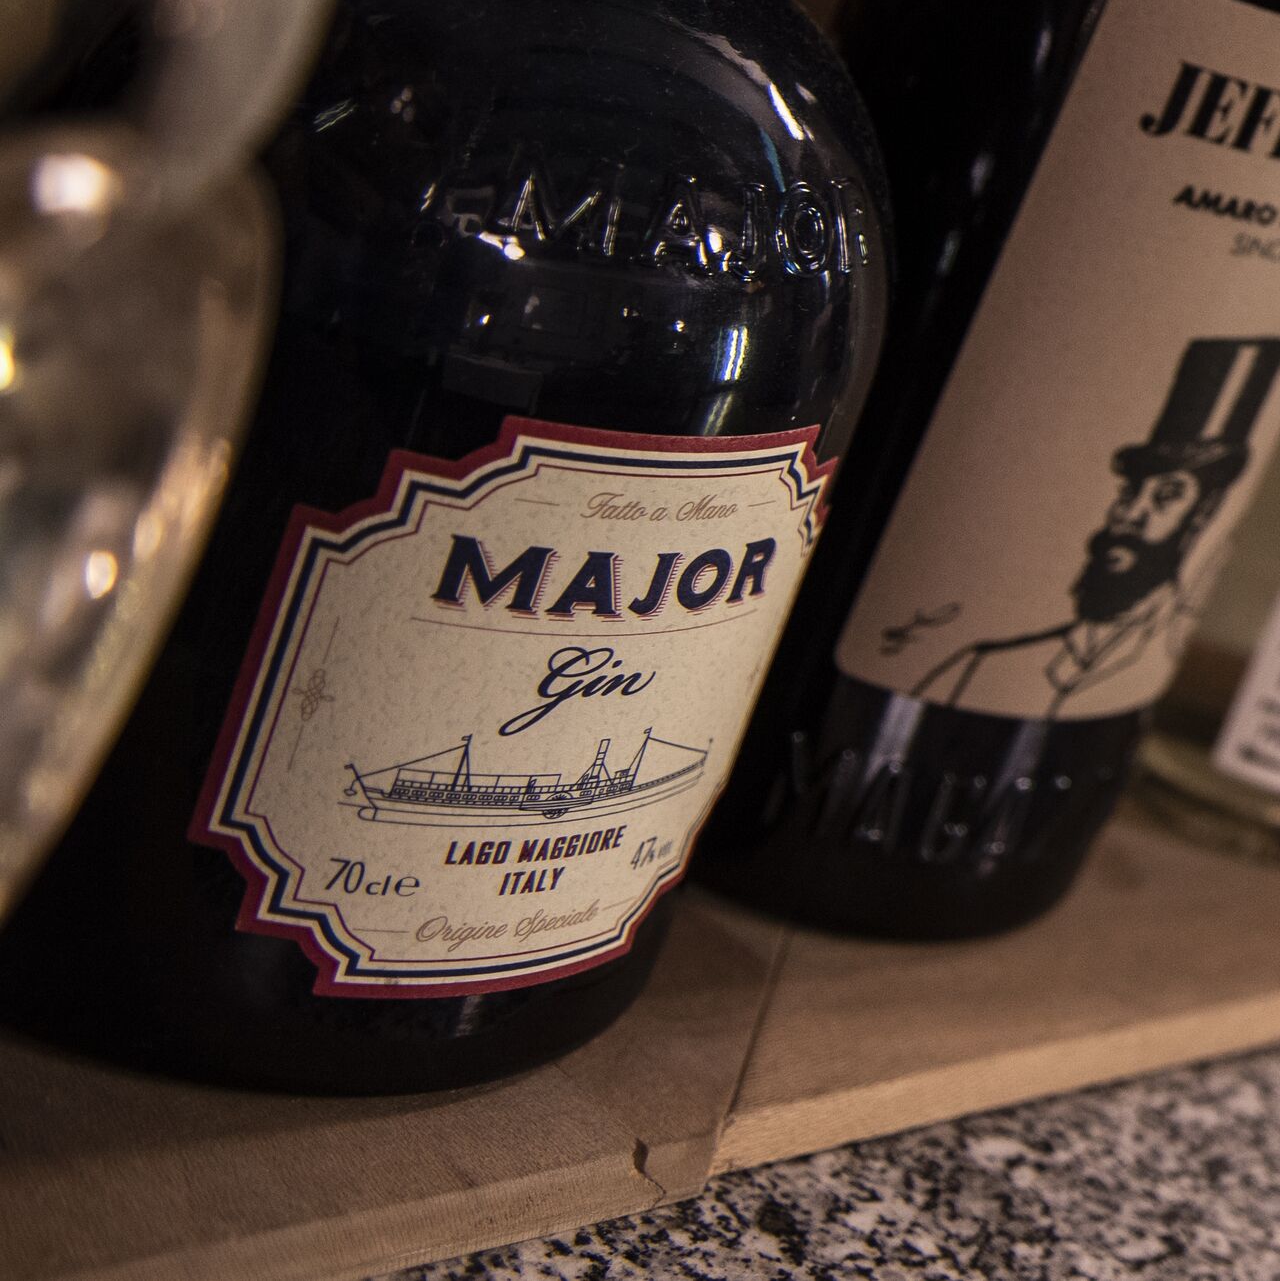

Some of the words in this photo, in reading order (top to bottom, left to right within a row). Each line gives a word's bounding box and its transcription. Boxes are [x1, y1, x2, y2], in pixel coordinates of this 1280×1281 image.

[1171, 184, 1278, 227] AMARO
[580, 492, 648, 521] Fatto
[649, 506, 669, 522] a
[674, 494, 738, 522] Mano
[430, 534, 776, 622] MAJOR
[499, 645, 656, 736] Gin
[444, 840, 512, 866] LAGO
[517, 825, 628, 864] MAGGIORE
[498, 866, 567, 897] ITALY
[415, 915, 508, 954] Origine
[513, 899, 600, 944] Speciale
